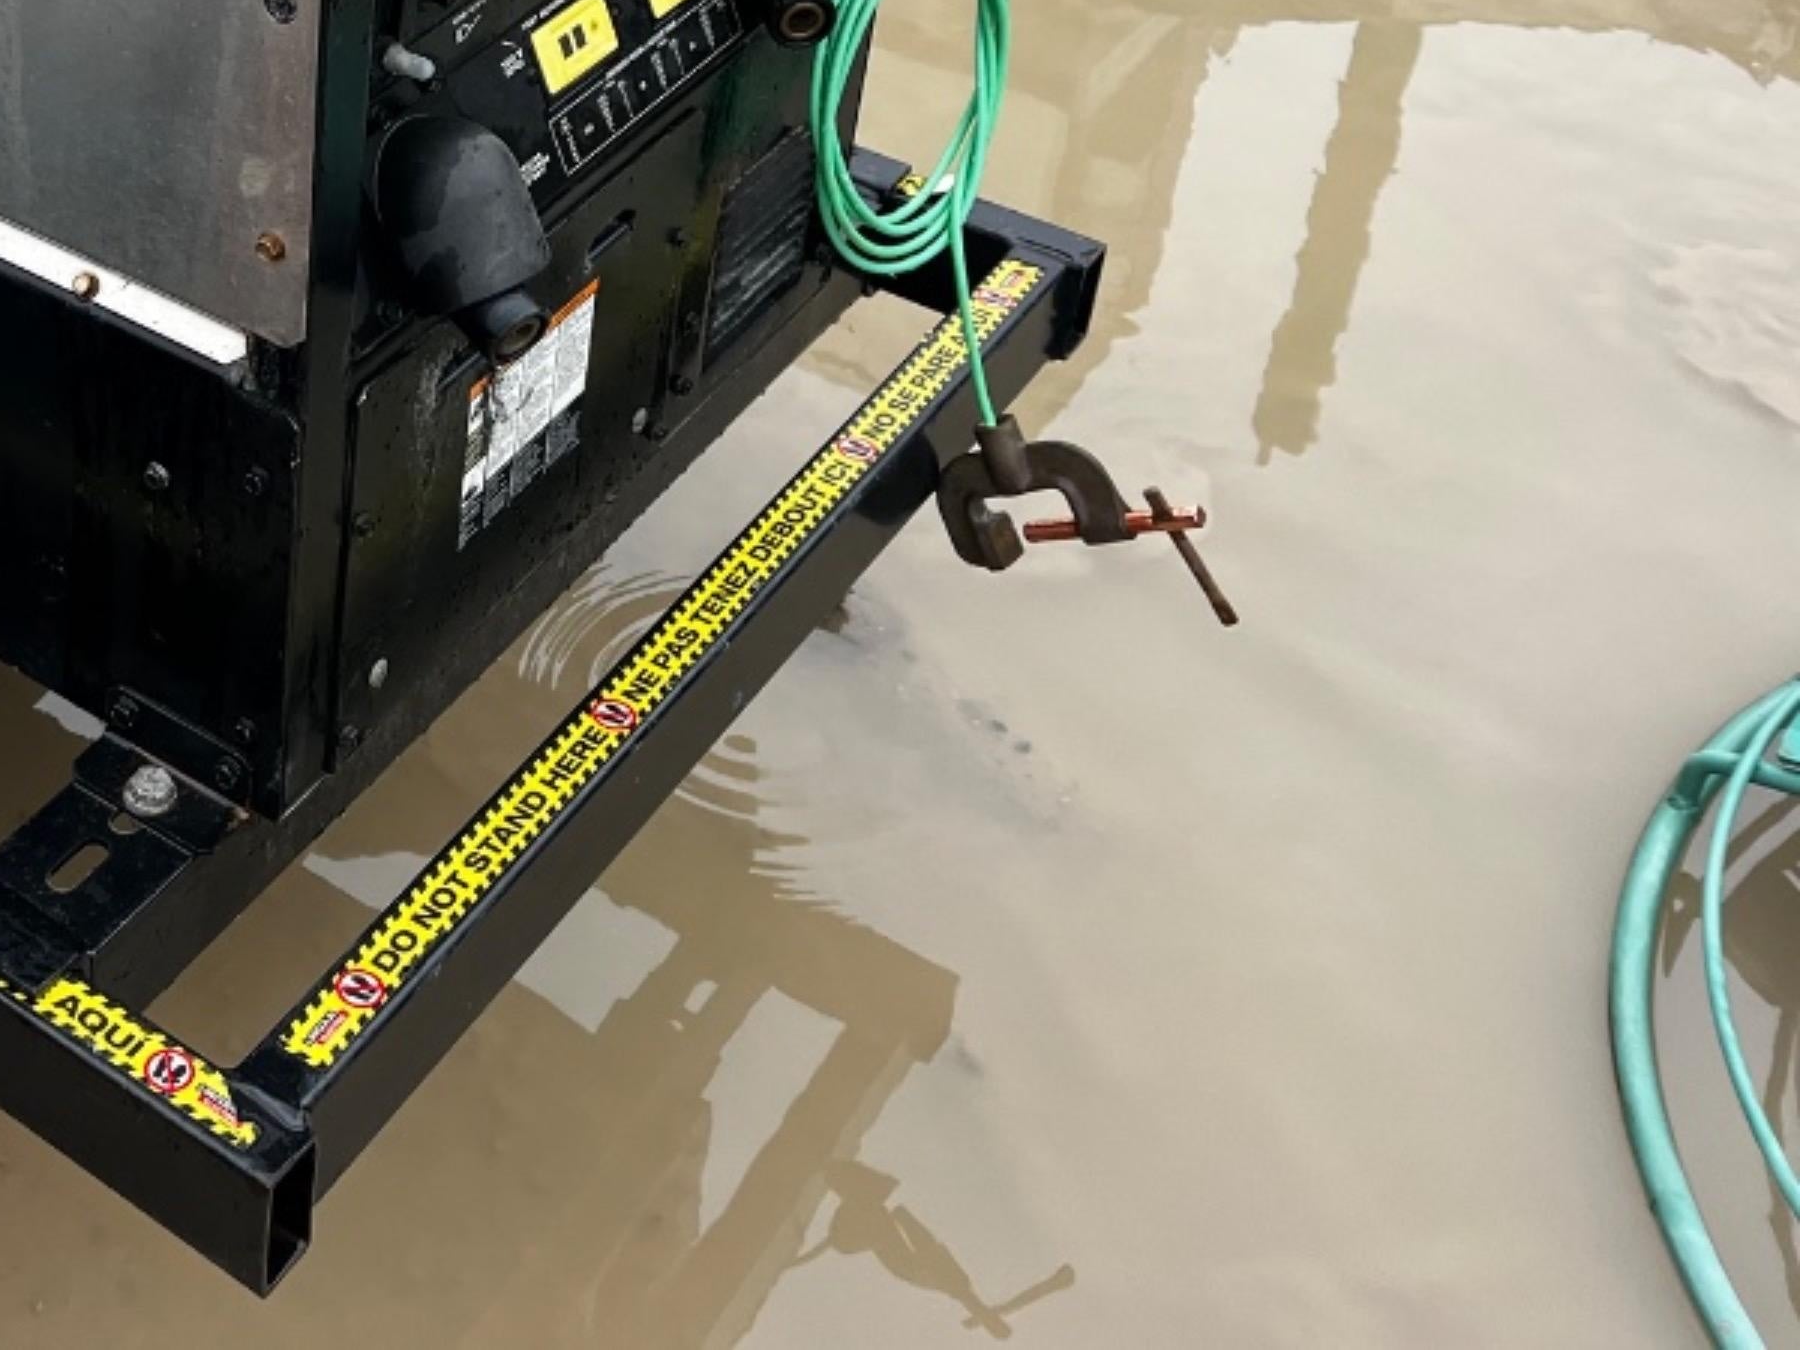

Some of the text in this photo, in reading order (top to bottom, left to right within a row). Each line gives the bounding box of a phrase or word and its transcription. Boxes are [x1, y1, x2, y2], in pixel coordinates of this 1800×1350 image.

[861, 413, 896, 442] NO
[887, 386, 920, 411] SE
[909, 344, 961, 390] PARE
[621, 459, 852, 704] NE PAS TENEZ DEBOUT ICI
[372, 726, 609, 974] DO NOT STAND HERE
